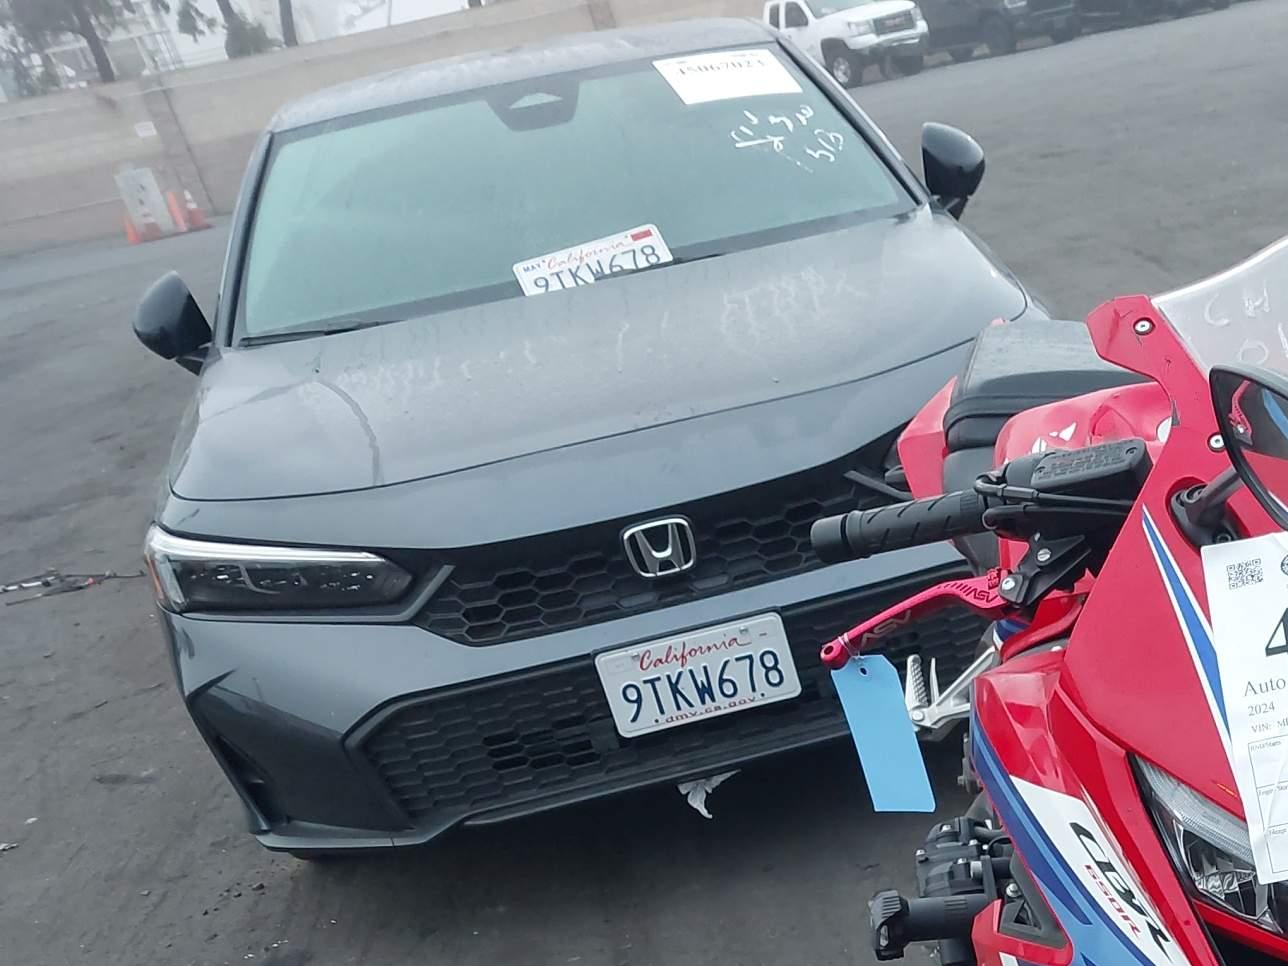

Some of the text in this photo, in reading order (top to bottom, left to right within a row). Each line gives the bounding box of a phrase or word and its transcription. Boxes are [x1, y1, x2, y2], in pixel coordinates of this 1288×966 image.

[547, 240, 625, 271] California
[639, 636, 753, 671] California
[622, 650, 785, 723] 9TKW678
[1244, 677, 1286, 697] Auto
[665, 696, 756, 724] dmv.ca.gov
[1248, 701, 1275, 716] 2024
[1251, 723, 1272, 734] VIN:
[1069, 822, 1174, 964] CBR
